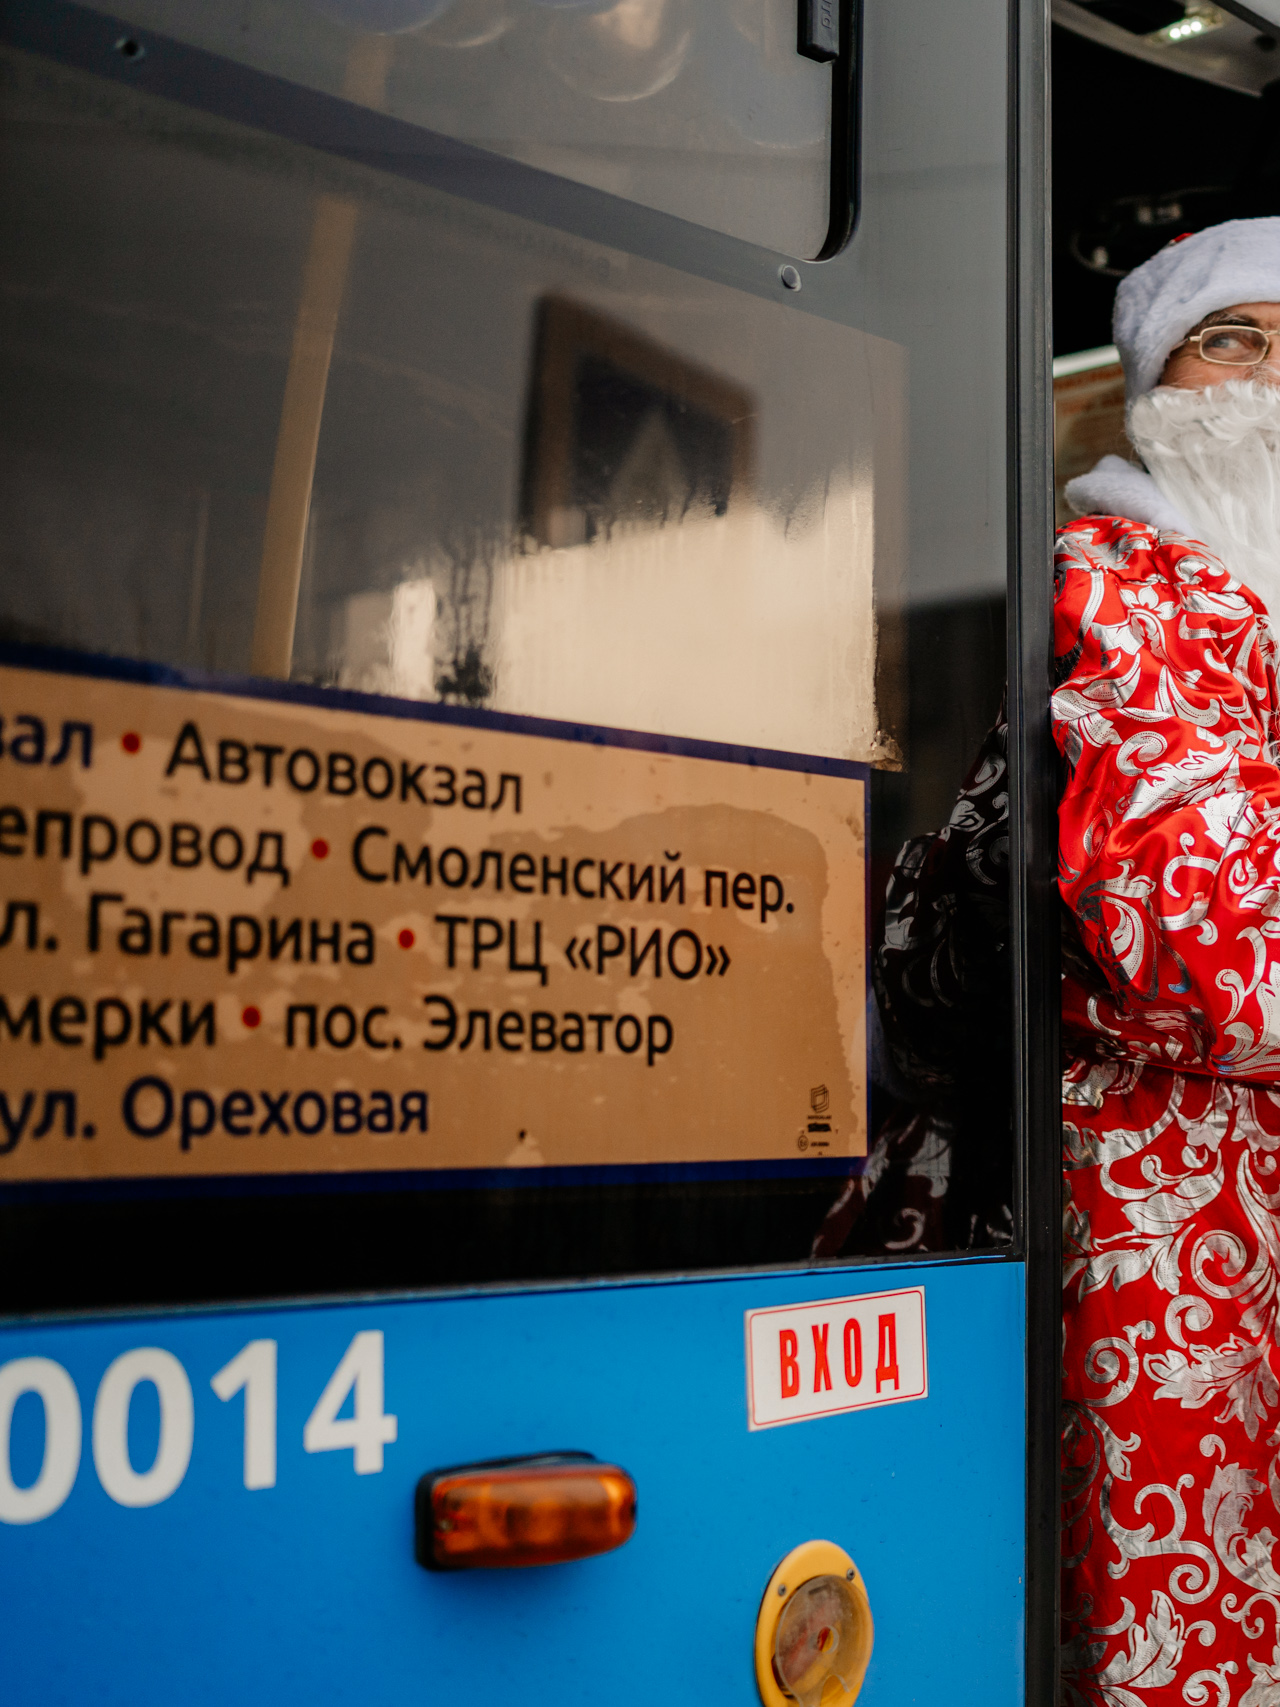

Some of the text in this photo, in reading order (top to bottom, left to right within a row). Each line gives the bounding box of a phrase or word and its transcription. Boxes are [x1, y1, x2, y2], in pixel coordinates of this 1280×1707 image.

[0, 714, 524, 813] ал Автовокзал
[0, 804, 794, 923] епровод Смоленский пер.
[0, 892, 731, 985] л. Гагарина ТРЦ «РИО»
[0, 993, 673, 1066] мерки пос. Элеватор
[0, 1074, 429, 1157] ул. Ореховая
[778, 1312, 900, 1400] ВХОД
[0, 1330, 398, 1525] 0014
